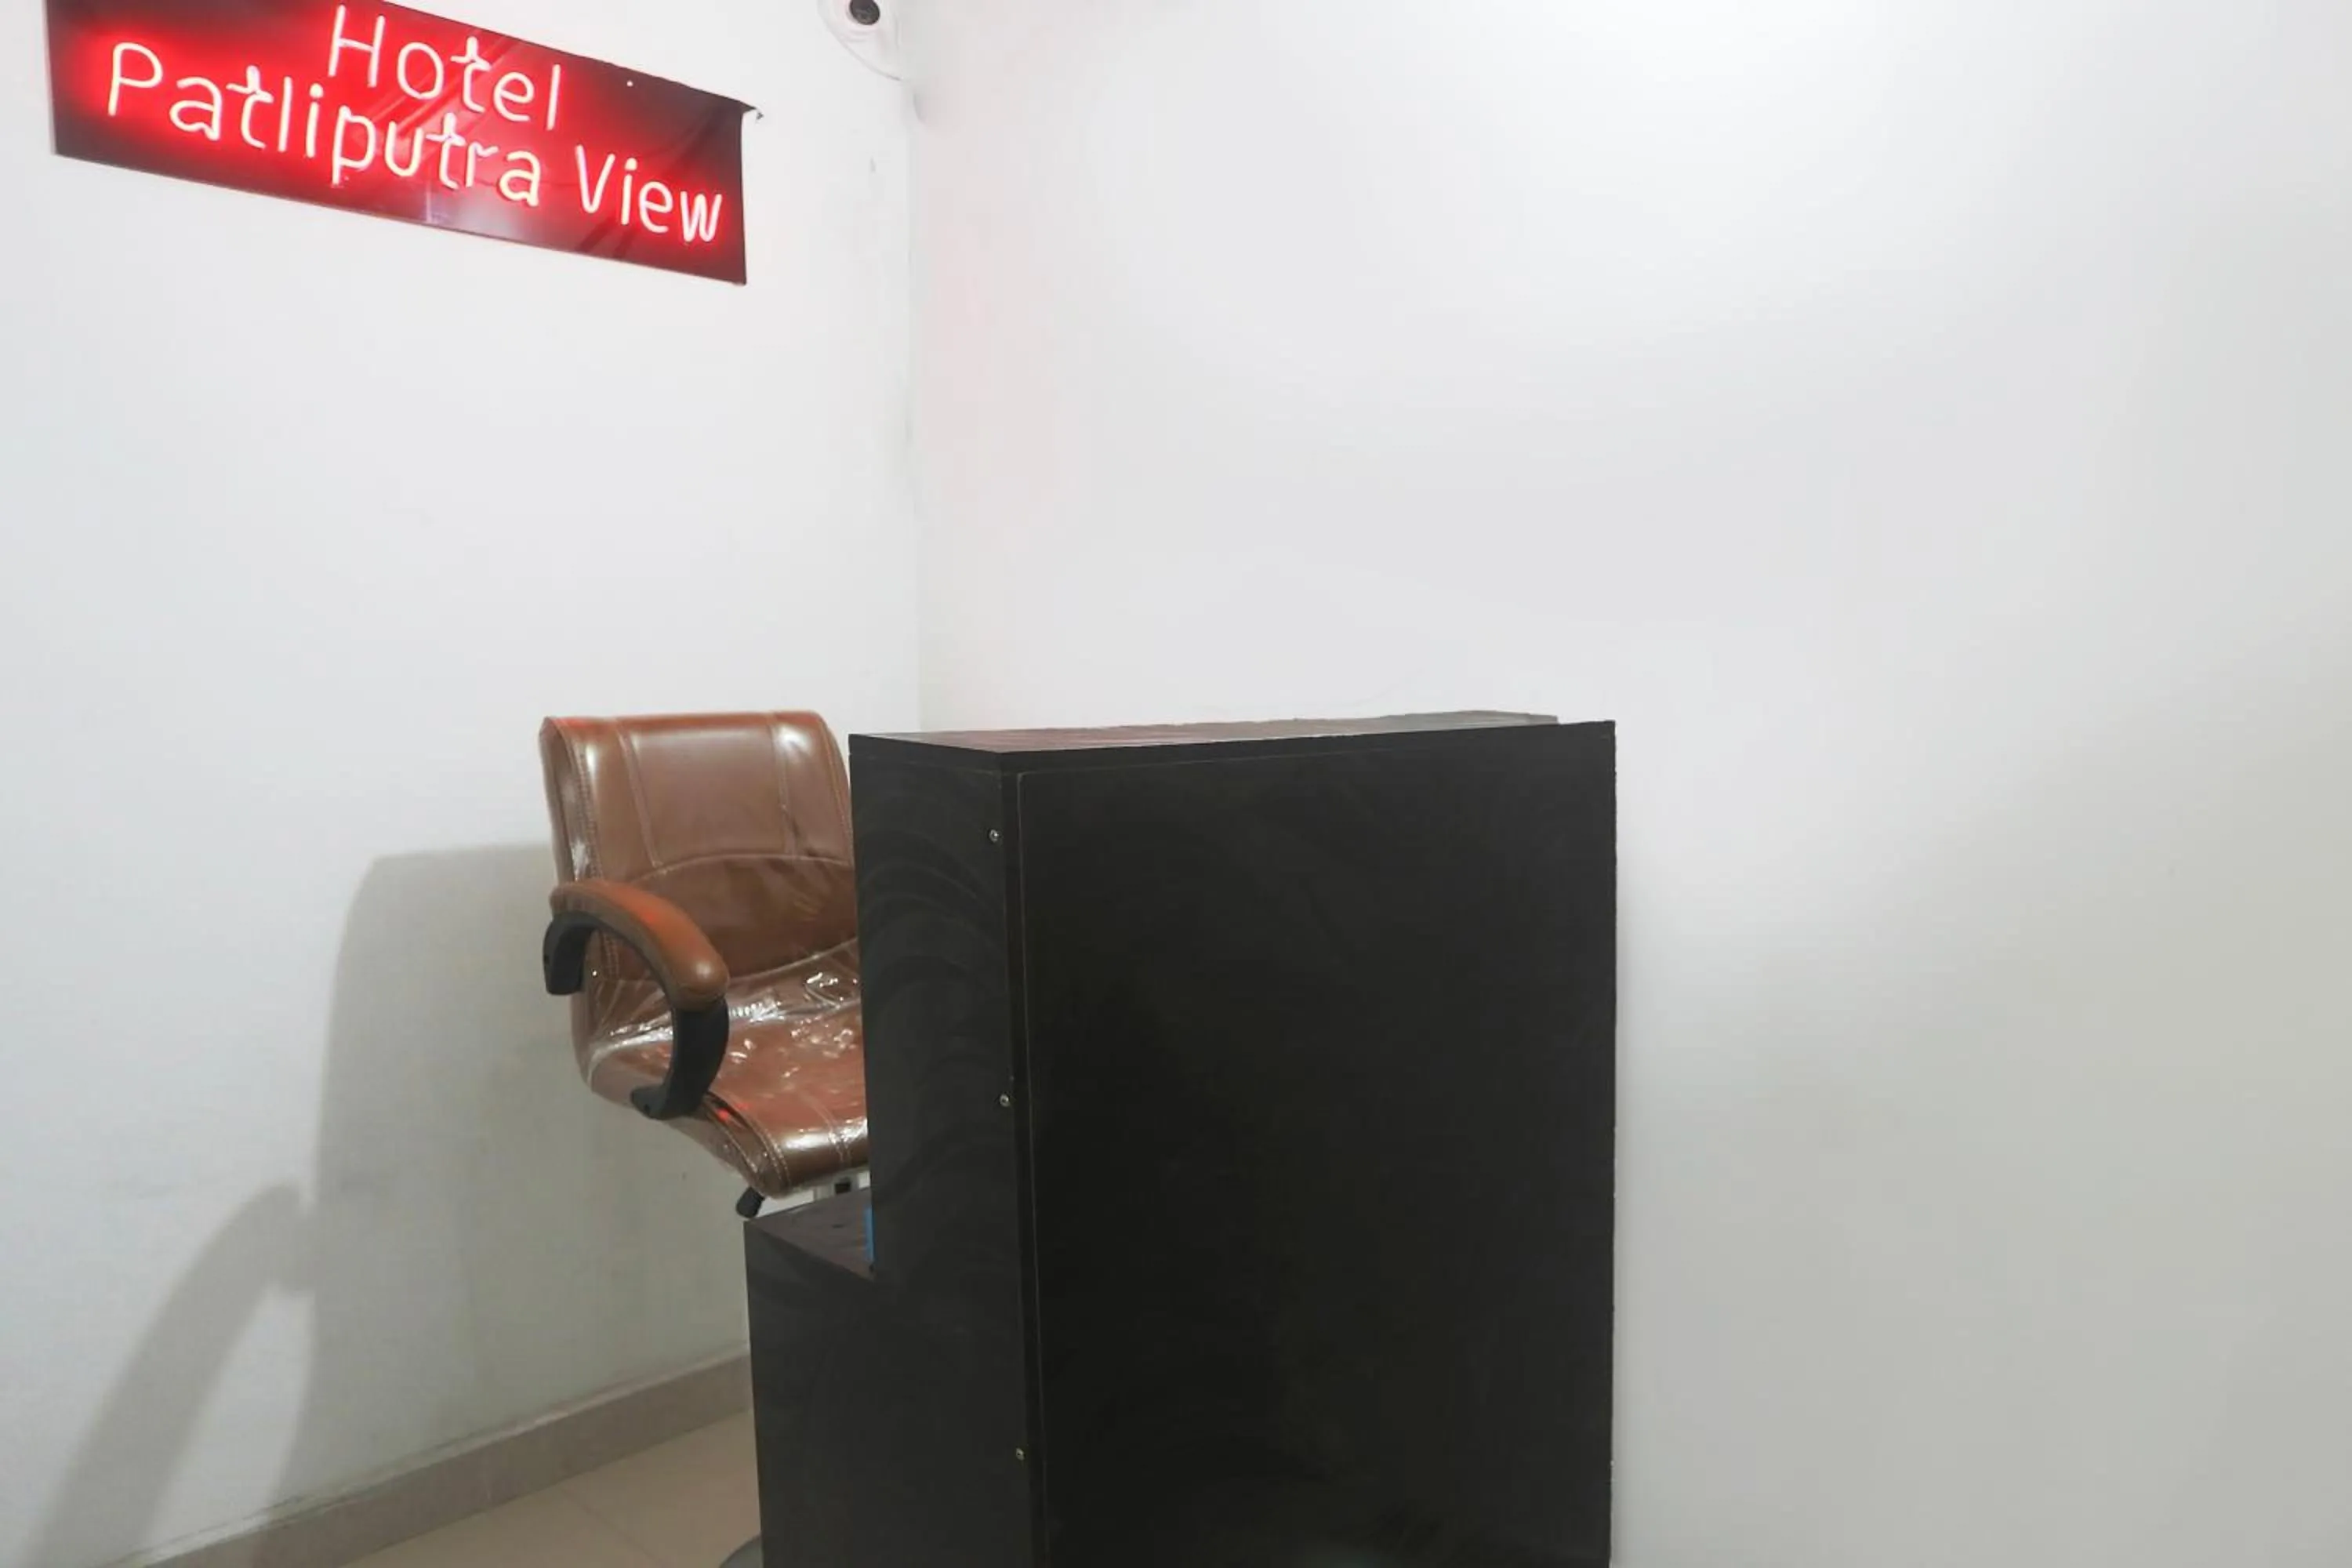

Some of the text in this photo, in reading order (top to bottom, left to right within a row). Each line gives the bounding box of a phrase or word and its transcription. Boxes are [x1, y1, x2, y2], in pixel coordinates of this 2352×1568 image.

[107, 42, 724, 244] Patliputra View
[327, 5, 562, 129] Hotel
